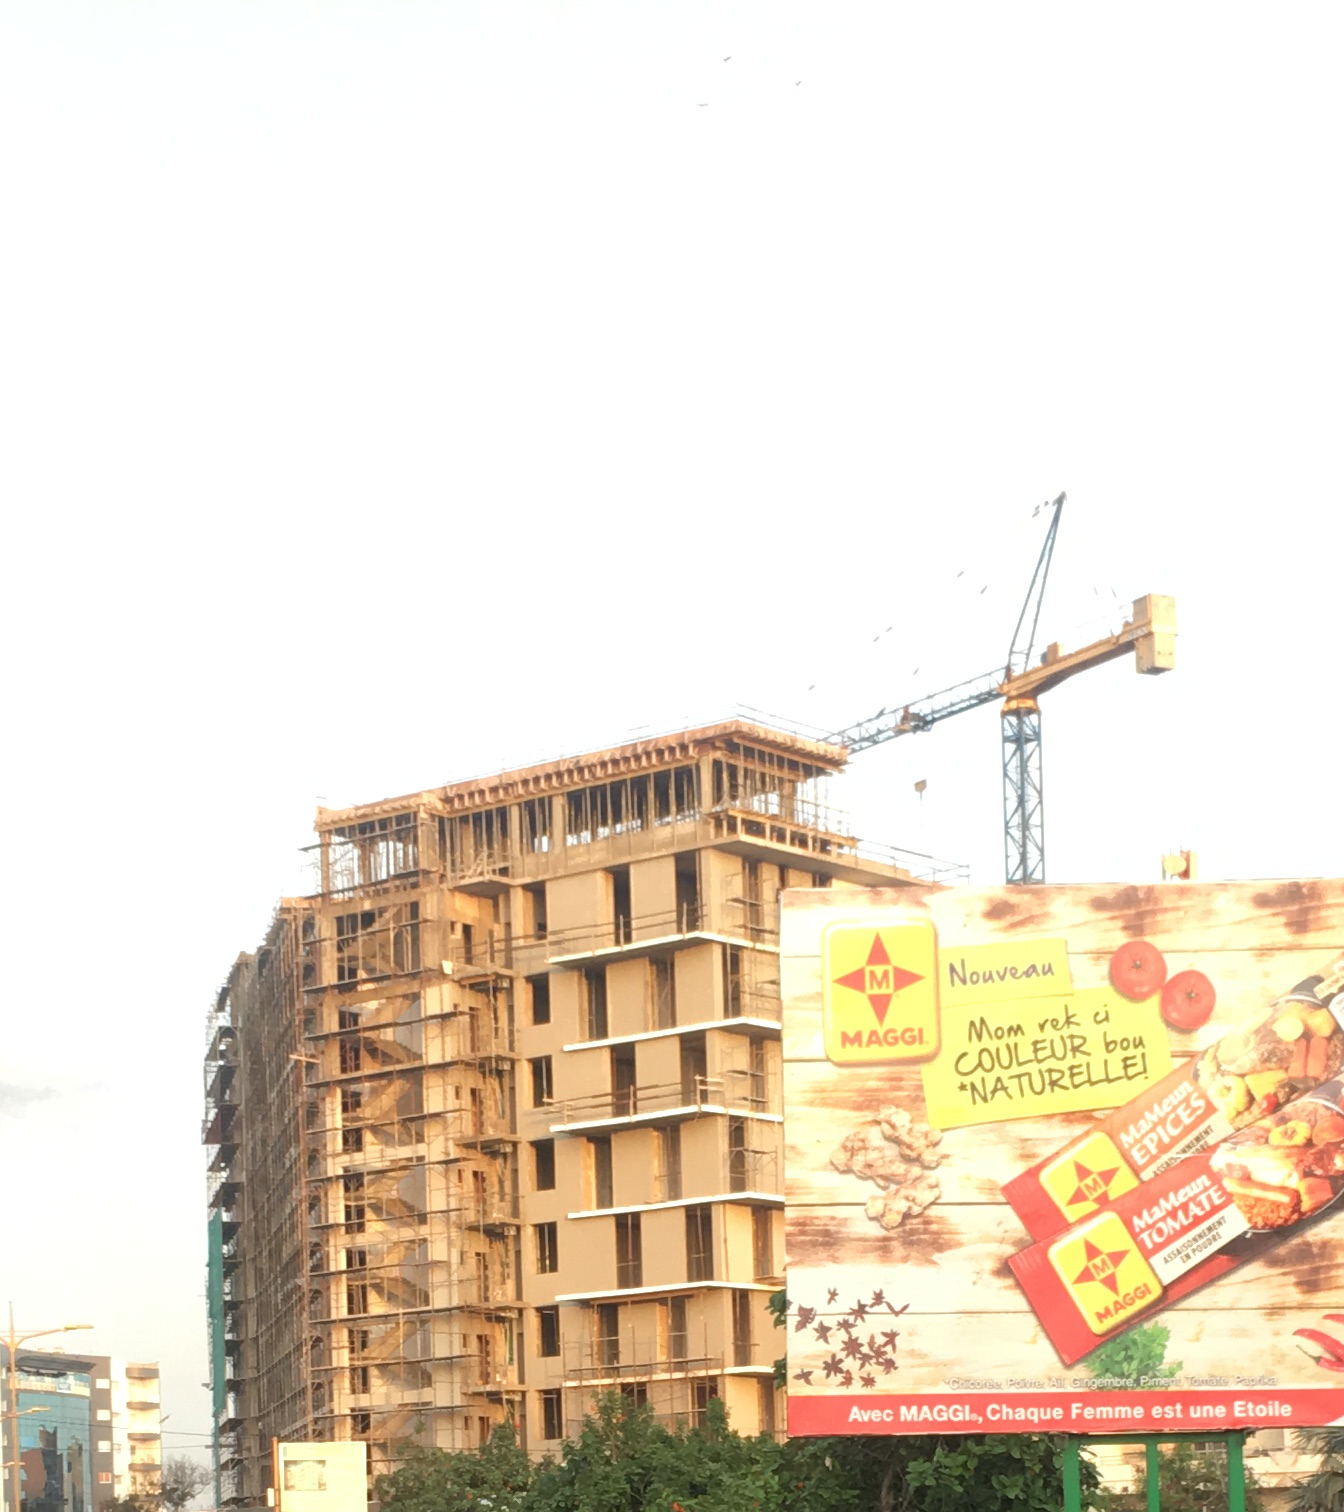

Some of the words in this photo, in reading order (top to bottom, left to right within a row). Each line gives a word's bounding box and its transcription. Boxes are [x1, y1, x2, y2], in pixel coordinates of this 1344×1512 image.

[948, 958, 1055, 987] Nouveau
[840, 1027, 925, 1049] MAGGI
[967, 1016, 1025, 1043] Mom
[1039, 1004, 1082, 1032] rek
[1093, 1003, 1111, 1025] ci
[953, 1034, 1092, 1077] COULEUR
[1103, 1031, 1146, 1054] bou
[1130, 1092, 1206, 1167] EPICES
[1132, 1174, 1212, 1233] MaMeun
[1137, 1185, 1227, 1250] TOMATE
[1163, 1215, 1227, 1264] ASSAISONNEMENT
[1094, 1282, 1152, 1324] MAGGI
[848, 1405, 894, 1422] Avec
[986, 1403, 1064, 1425] Chaque
[1070, 1402, 1145, 1420] Femme
[1151, 1402, 1183, 1419] est
[1189, 1403, 1227, 1419] une
[1233, 1400, 1292, 1417] Etoile
